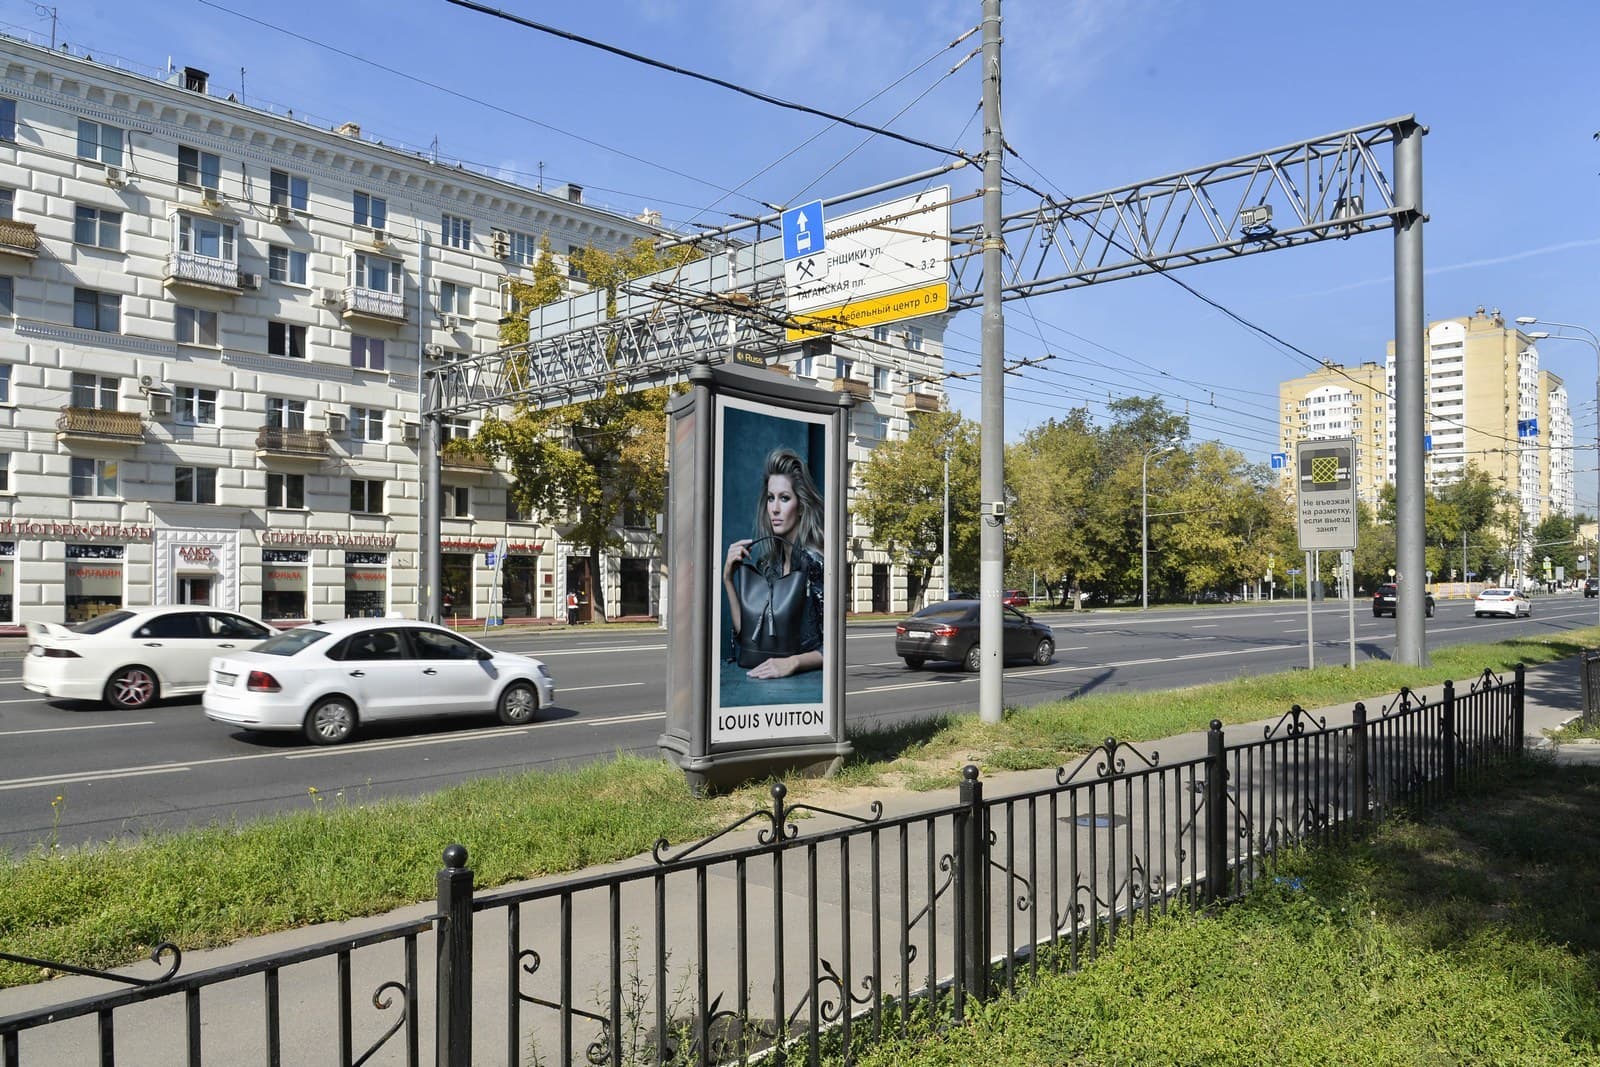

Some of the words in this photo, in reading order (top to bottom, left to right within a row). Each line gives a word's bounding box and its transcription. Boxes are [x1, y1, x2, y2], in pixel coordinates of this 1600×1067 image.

[870, 247, 884, 259] ул.
[852, 279, 866, 288] пл.
[921, 258, 936, 271] 3.2
[893, 299, 920, 313] центр
[924, 292, 938, 305] 0.9
[1316, 498, 1350, 506] въезжай
[262, 531, 333, 545] СПИРТНЫЕ
[337, 534, 396, 547] НАПИТКИ
[179, 546, 210, 556] АЛКО
[719, 713, 759, 731] LOUIS
[765, 710, 823, 727] VUITTON
